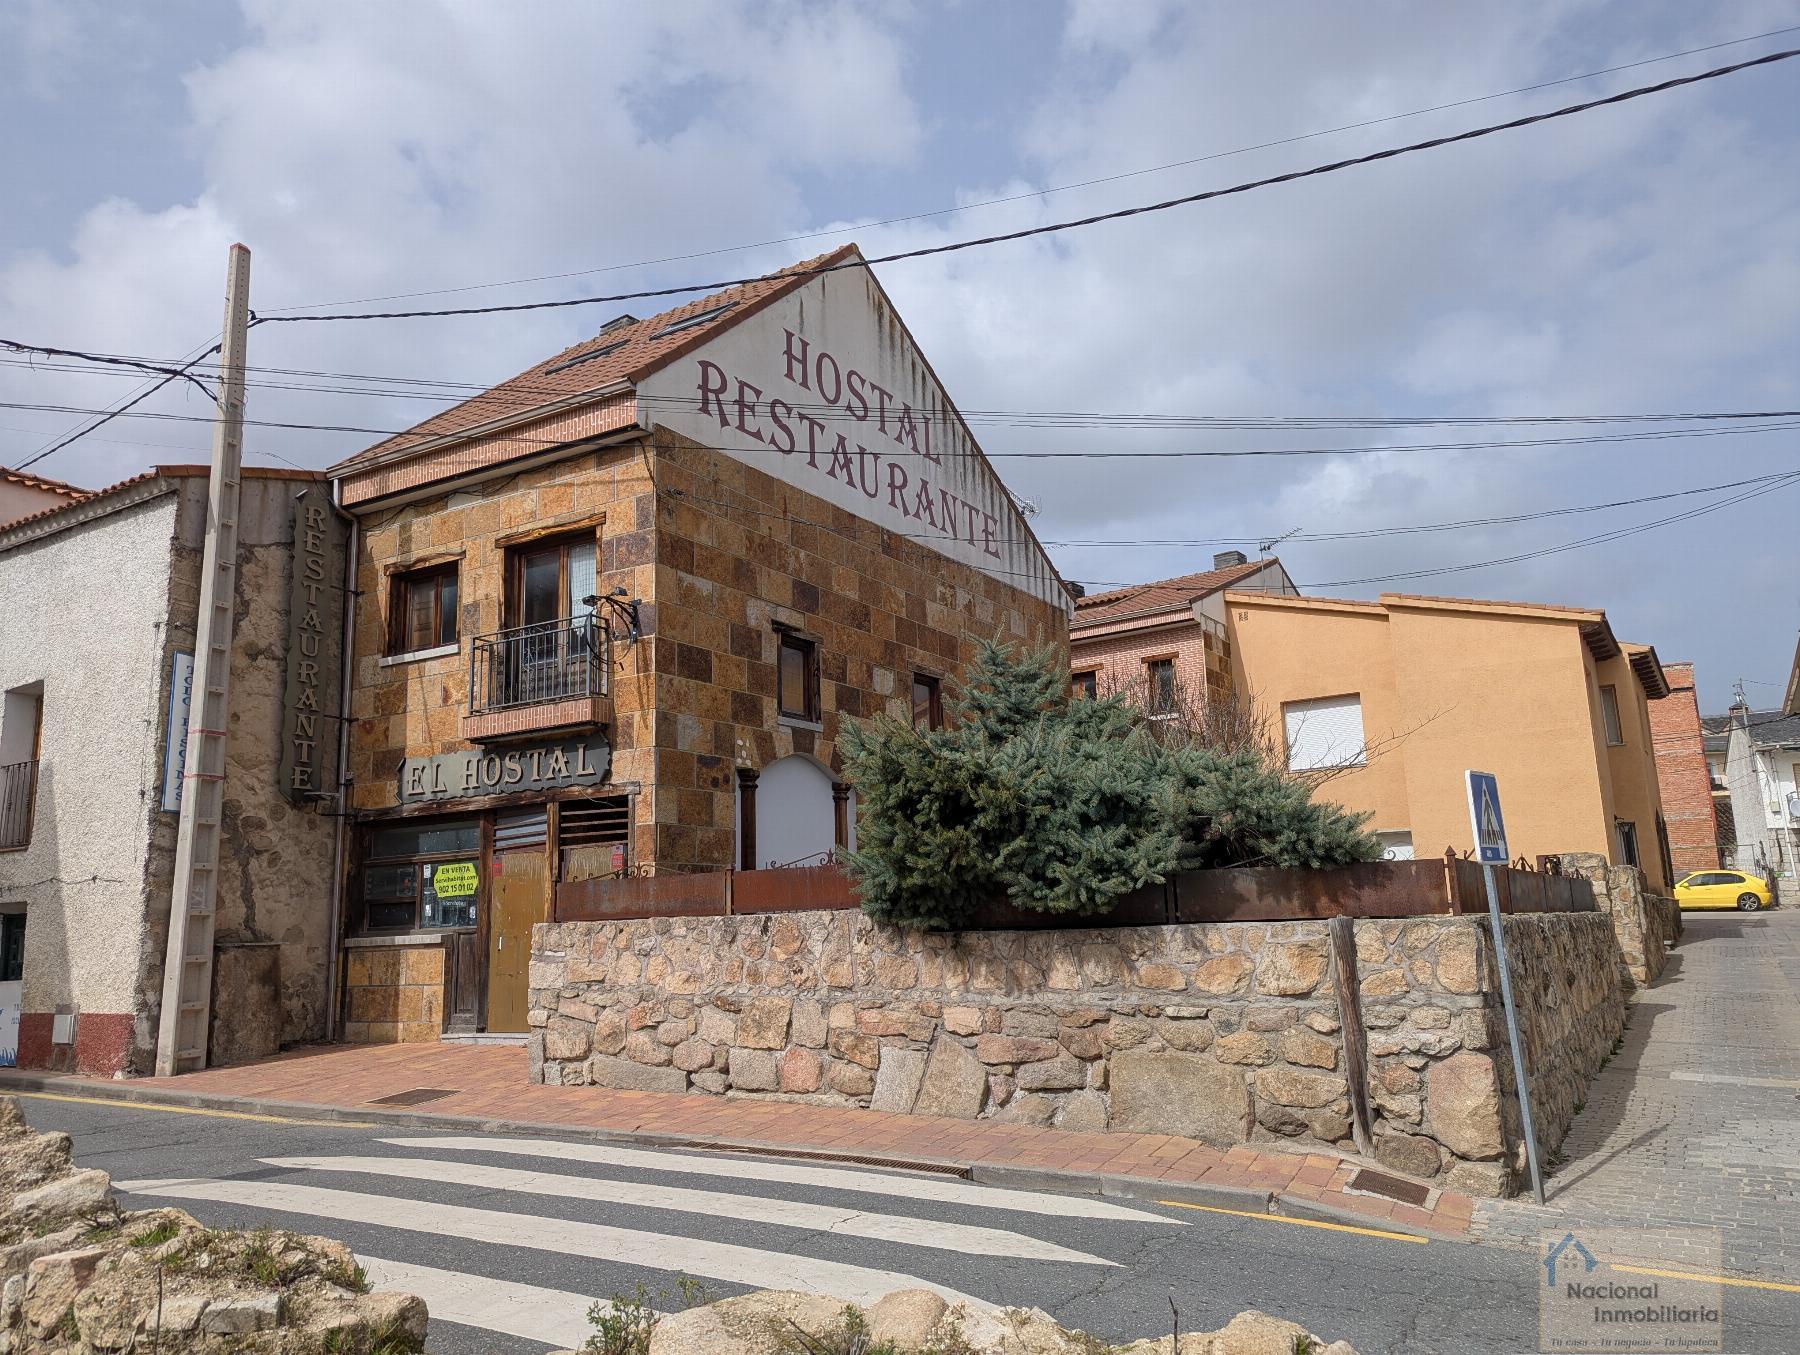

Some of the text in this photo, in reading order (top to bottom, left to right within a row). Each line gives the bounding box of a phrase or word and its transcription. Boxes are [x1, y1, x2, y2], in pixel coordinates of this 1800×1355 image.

[783, 327, 942, 467] HOSTAL
[696, 359, 1002, 560] RESTAURANTE
[291, 505, 327, 790] RESTAURANTE
[407, 743, 597, 796] EL HOSTAL
[438, 883, 474, 893] 902 15 01 02
[451, 865, 471, 873] VENTA
